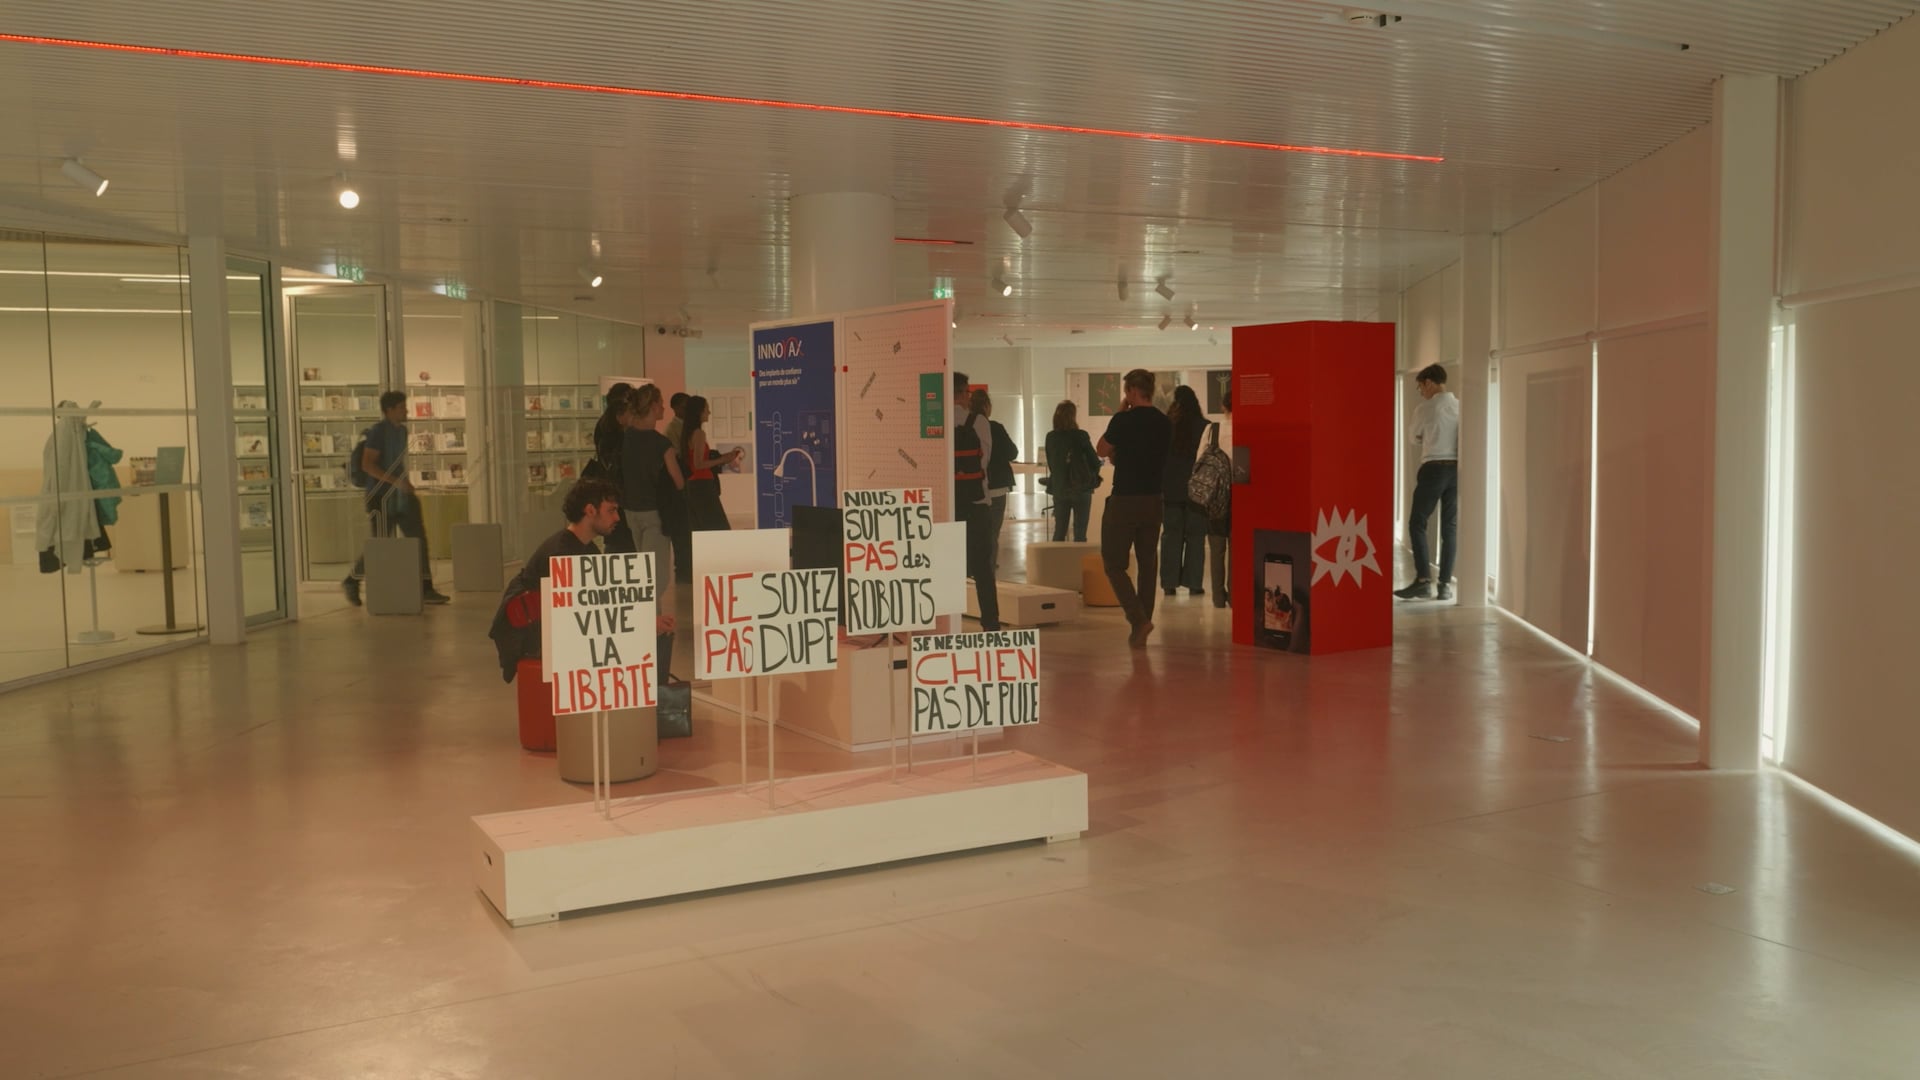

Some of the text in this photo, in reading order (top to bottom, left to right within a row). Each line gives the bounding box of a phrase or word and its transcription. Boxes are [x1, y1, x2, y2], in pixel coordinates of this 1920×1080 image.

[844, 489, 930, 507] NOUS NE
[551, 557, 573, 588] NI
[846, 540, 930, 574] PAS des
[552, 586, 654, 608] NI CONTROLE
[704, 570, 838, 627] NE SOYEZ
[847, 578, 935, 633] ROBOTS
[574, 605, 635, 636] VIVE
[589, 636, 622, 667] LA
[704, 617, 838, 674] PAS DUPE
[912, 630, 1036, 652] JE NE SUIS PAS UN
[553, 652, 656, 714] LIBERTÉ
[915, 647, 1037, 685] CHIEN
[914, 686, 962, 732] PAS
[964, 683, 994, 728] DE
